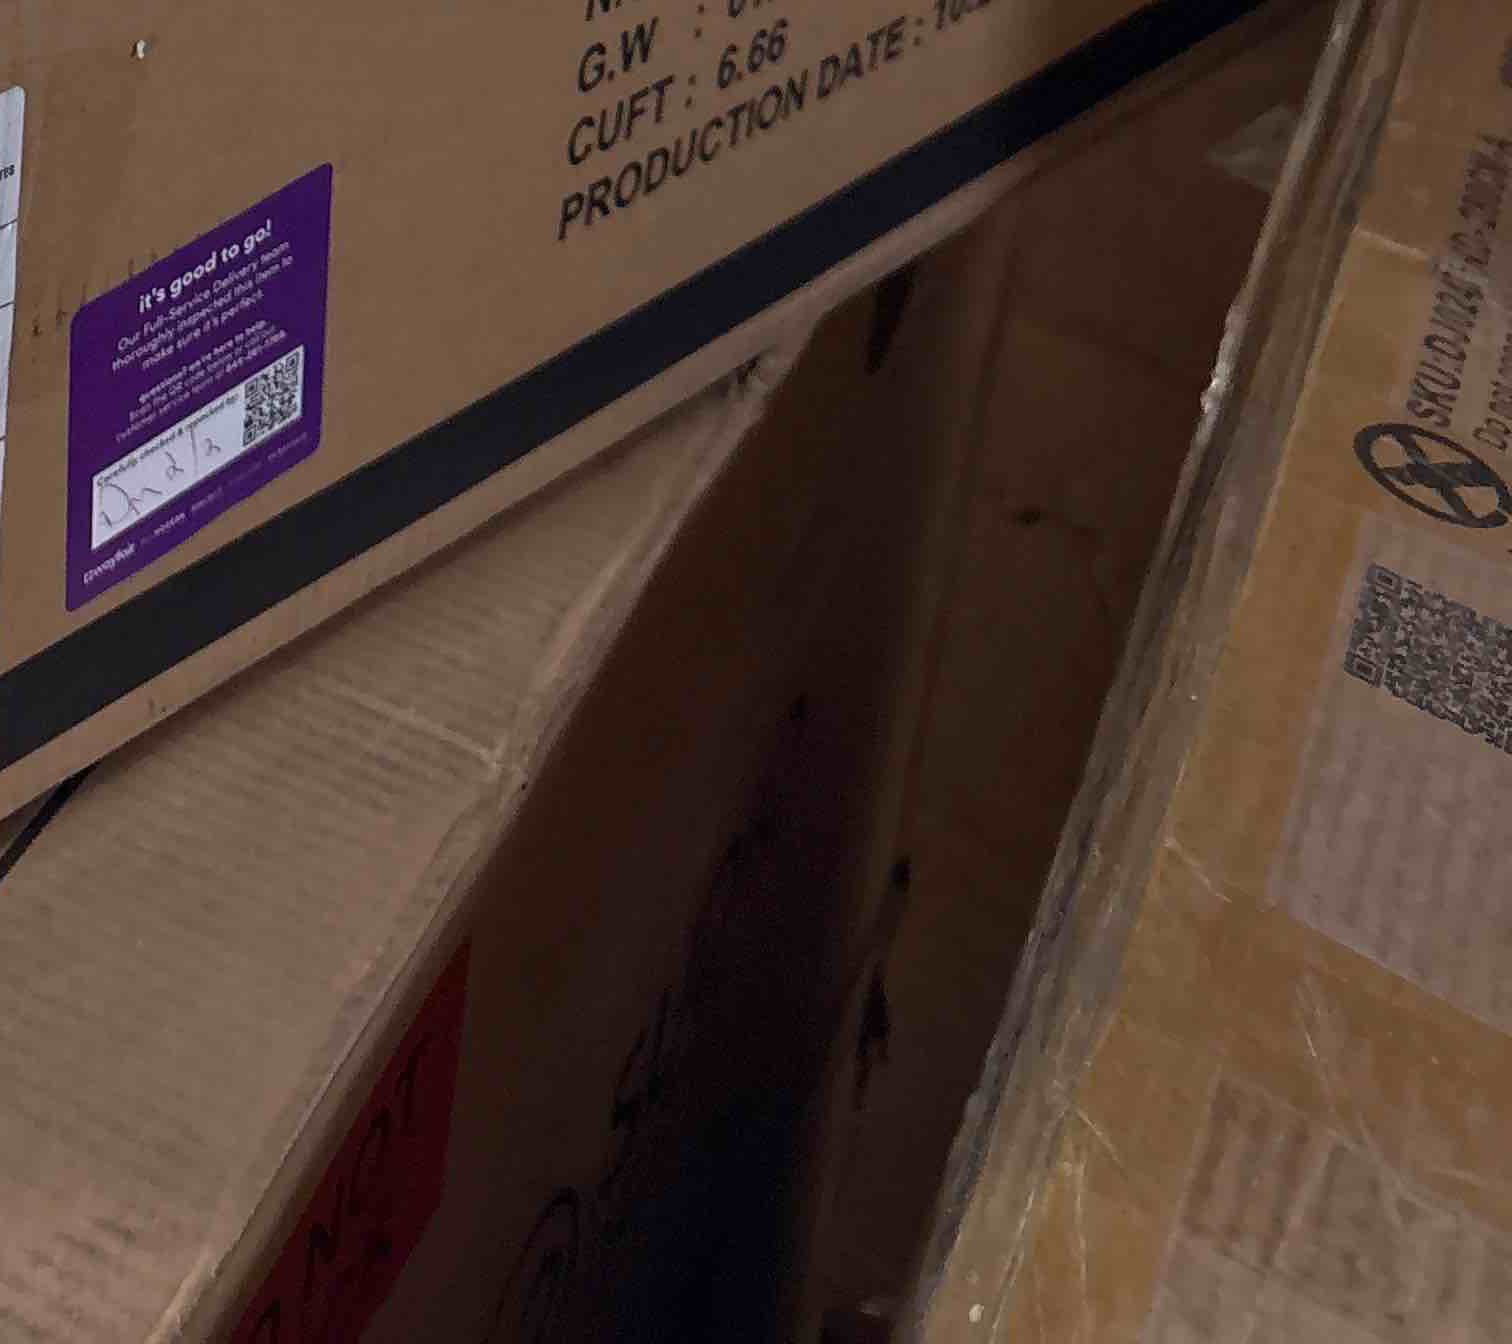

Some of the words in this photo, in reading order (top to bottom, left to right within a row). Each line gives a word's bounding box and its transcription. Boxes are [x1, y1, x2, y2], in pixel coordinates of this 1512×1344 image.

[567, 74, 676, 168] CUFT
[716, 17, 790, 92] 6.66
[576, 17, 658, 95] G.W
[557, 70, 810, 243] PRODUCTION
[139, 282, 165, 315] it's
[169, 249, 216, 301] good
[221, 239, 239, 264] to
[244, 216, 271, 255] go!
